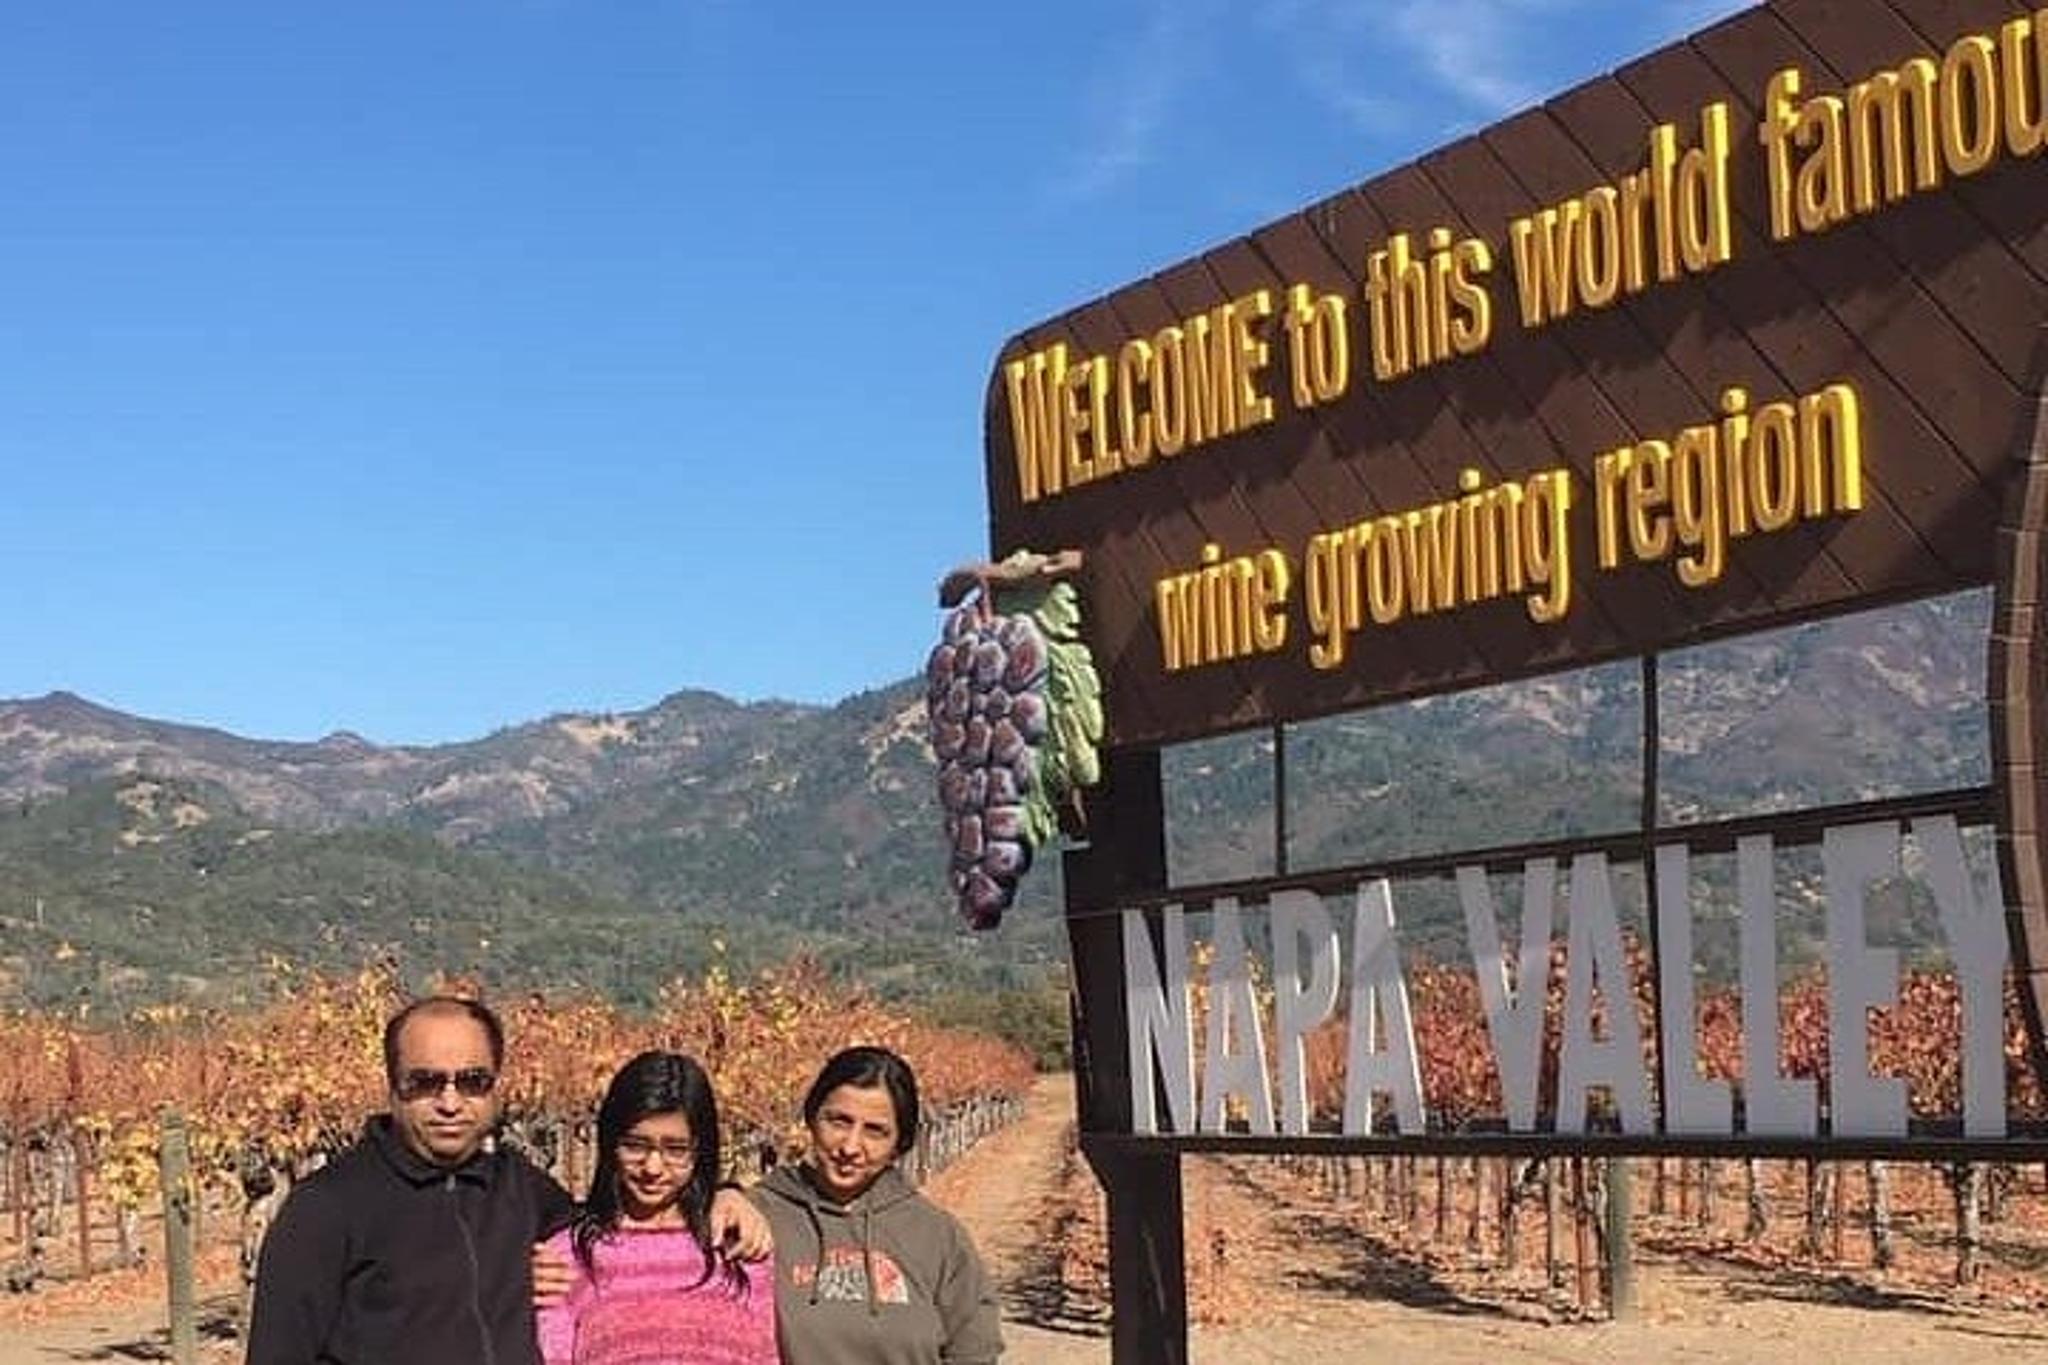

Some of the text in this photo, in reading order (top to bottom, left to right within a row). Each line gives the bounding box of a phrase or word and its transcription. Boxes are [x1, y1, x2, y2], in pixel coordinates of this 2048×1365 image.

[1284, 284, 1348, 408] to
[1366, 227, 1492, 381] this
[1509, 102, 1731, 329] world
[1157, 383, 1862, 670] wine growing region
[1122, 815, 2008, 1138] NAPA VALLEY
